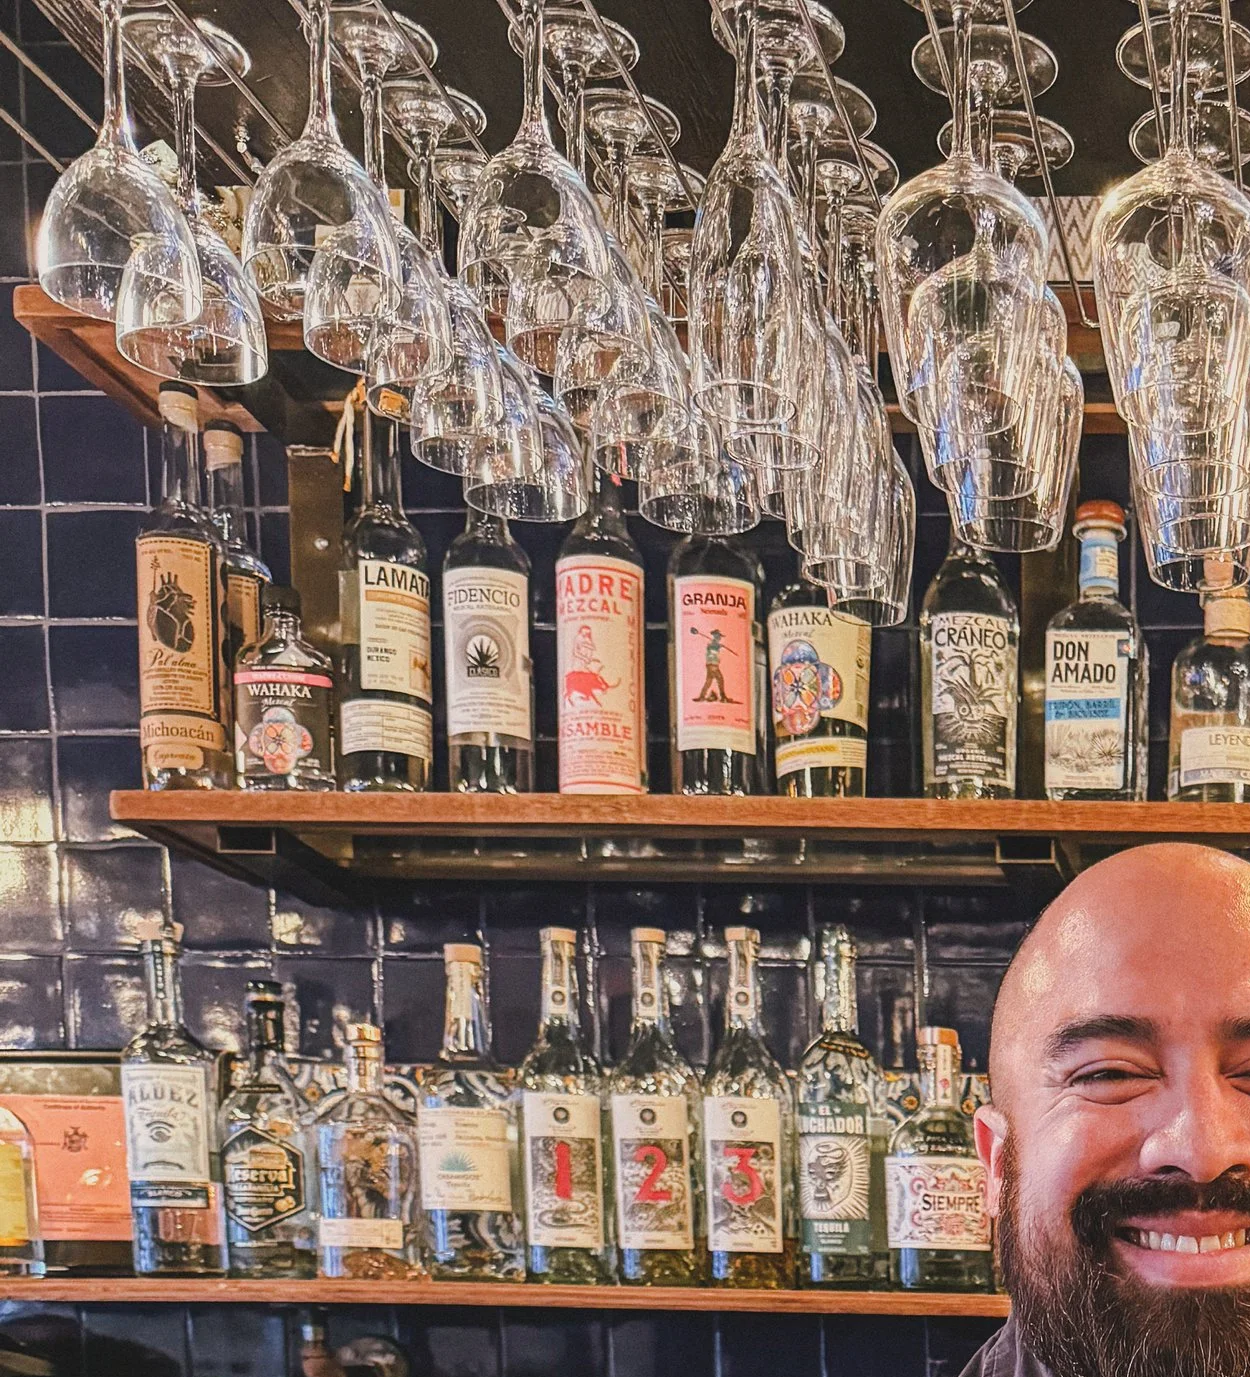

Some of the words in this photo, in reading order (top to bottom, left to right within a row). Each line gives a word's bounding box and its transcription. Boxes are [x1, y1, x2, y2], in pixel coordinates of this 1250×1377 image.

[557, 573, 634, 602] ADRE
[448, 588, 520, 608] FIDENCIO
[682, 592, 747, 610] GRANJA
[771, 611, 833, 630] WAHAKA
[940, 615, 1004, 631] MEZCAL
[934, 626, 1006, 650] CRÁNEO
[1053, 641, 1089, 662] DON
[1051, 663, 1117, 684] AMADO
[246, 683, 312, 699] WAHAKA
[142, 721, 215, 742] Michoacán
[818, 1106, 832, 1116] EL
[555, 1141, 572, 1200] 1
[632, 1145, 673, 1201] 2
[721, 1147, 767, 1205] 3
[922, 1194, 981, 1214] SIEMPRE
[814, 1221, 850, 1234] TEQUILA
